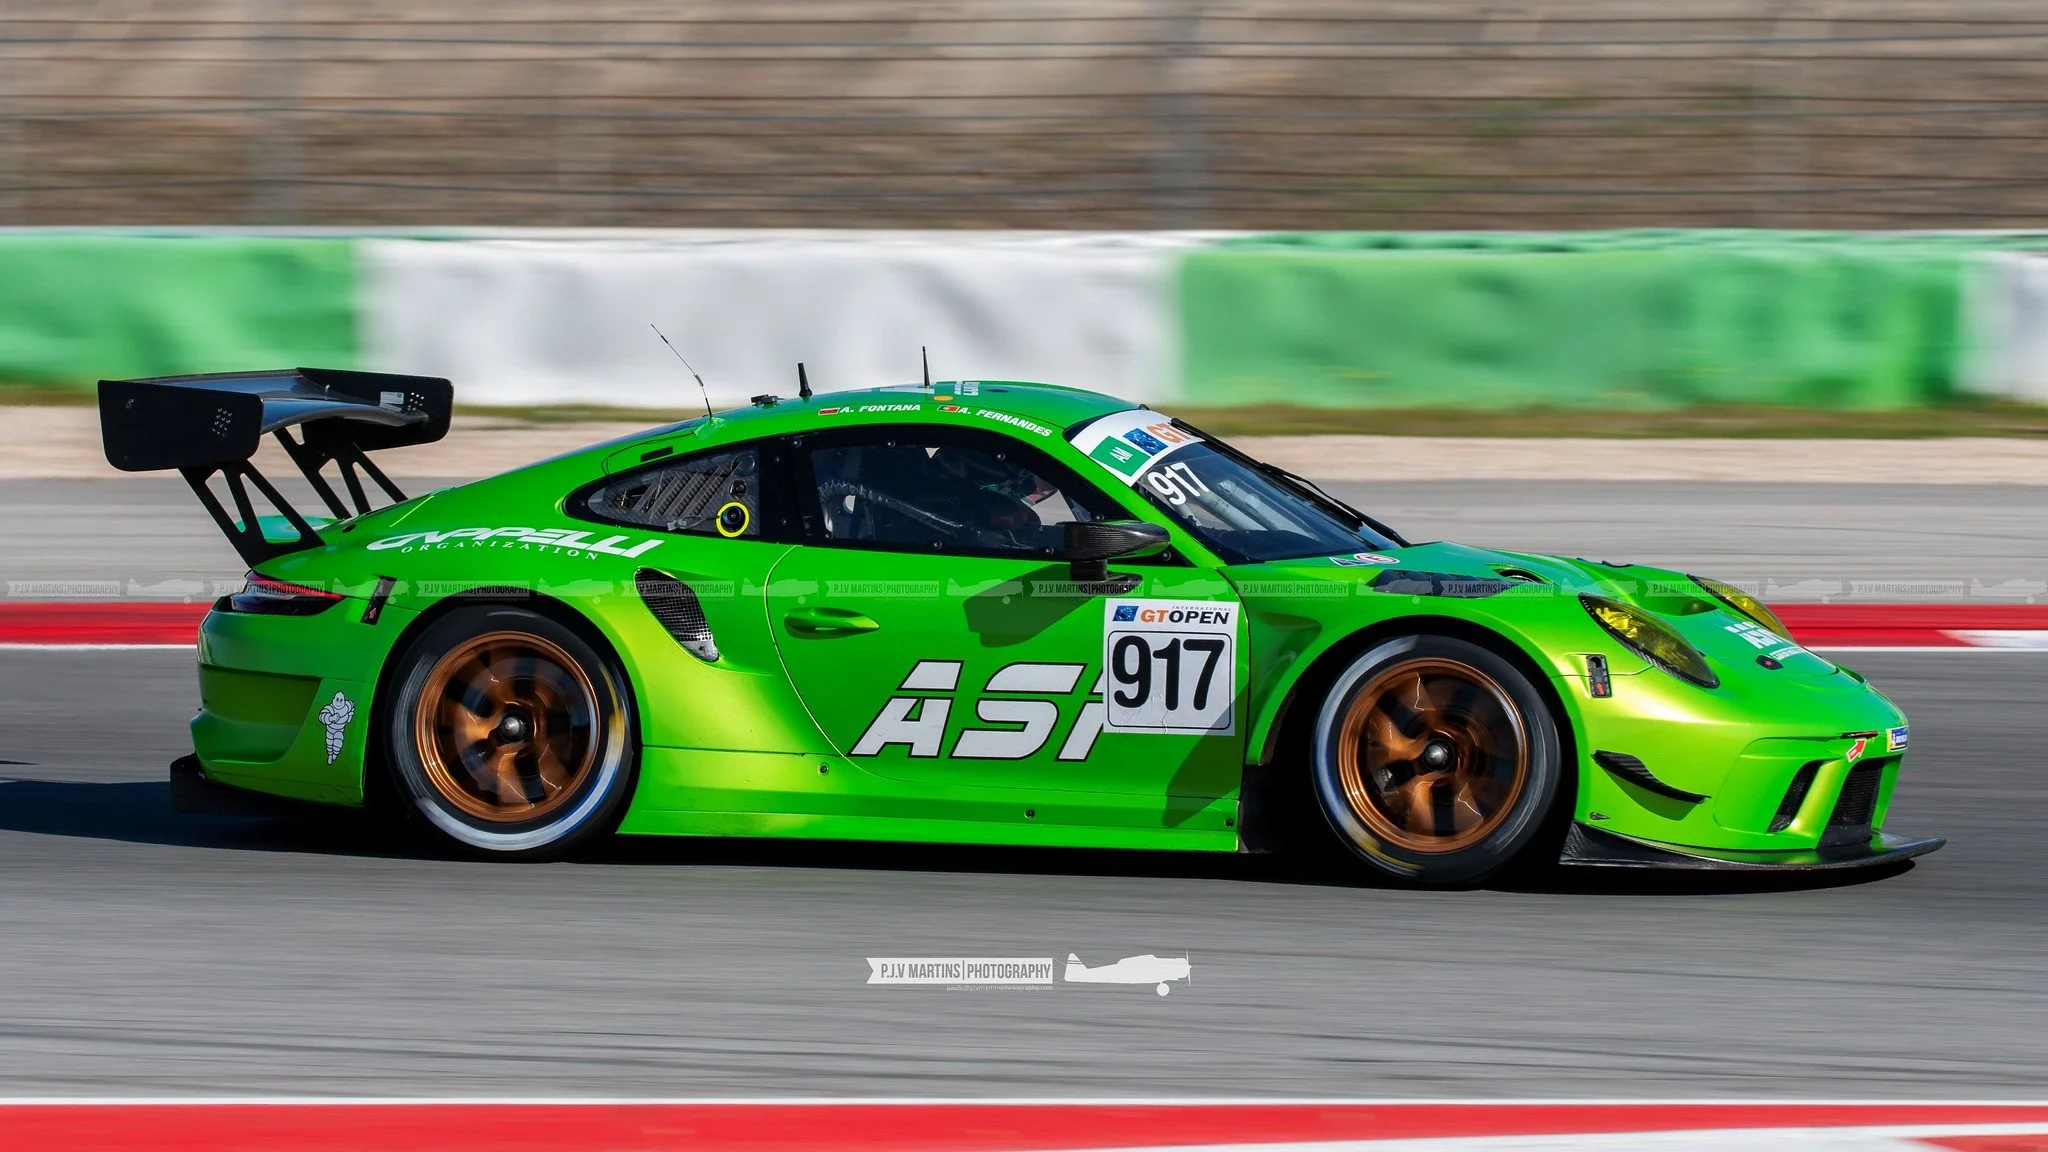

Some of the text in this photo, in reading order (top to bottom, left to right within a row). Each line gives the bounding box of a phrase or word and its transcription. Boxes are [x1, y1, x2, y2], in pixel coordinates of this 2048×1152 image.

[858, 403, 921, 413] FONTANA
[975, 408, 1053, 437] FERNANDES
[1147, 461, 1210, 506] 917
[400, 539, 599, 561] ORGANIZATION
[1111, 635, 1226, 712] 917
